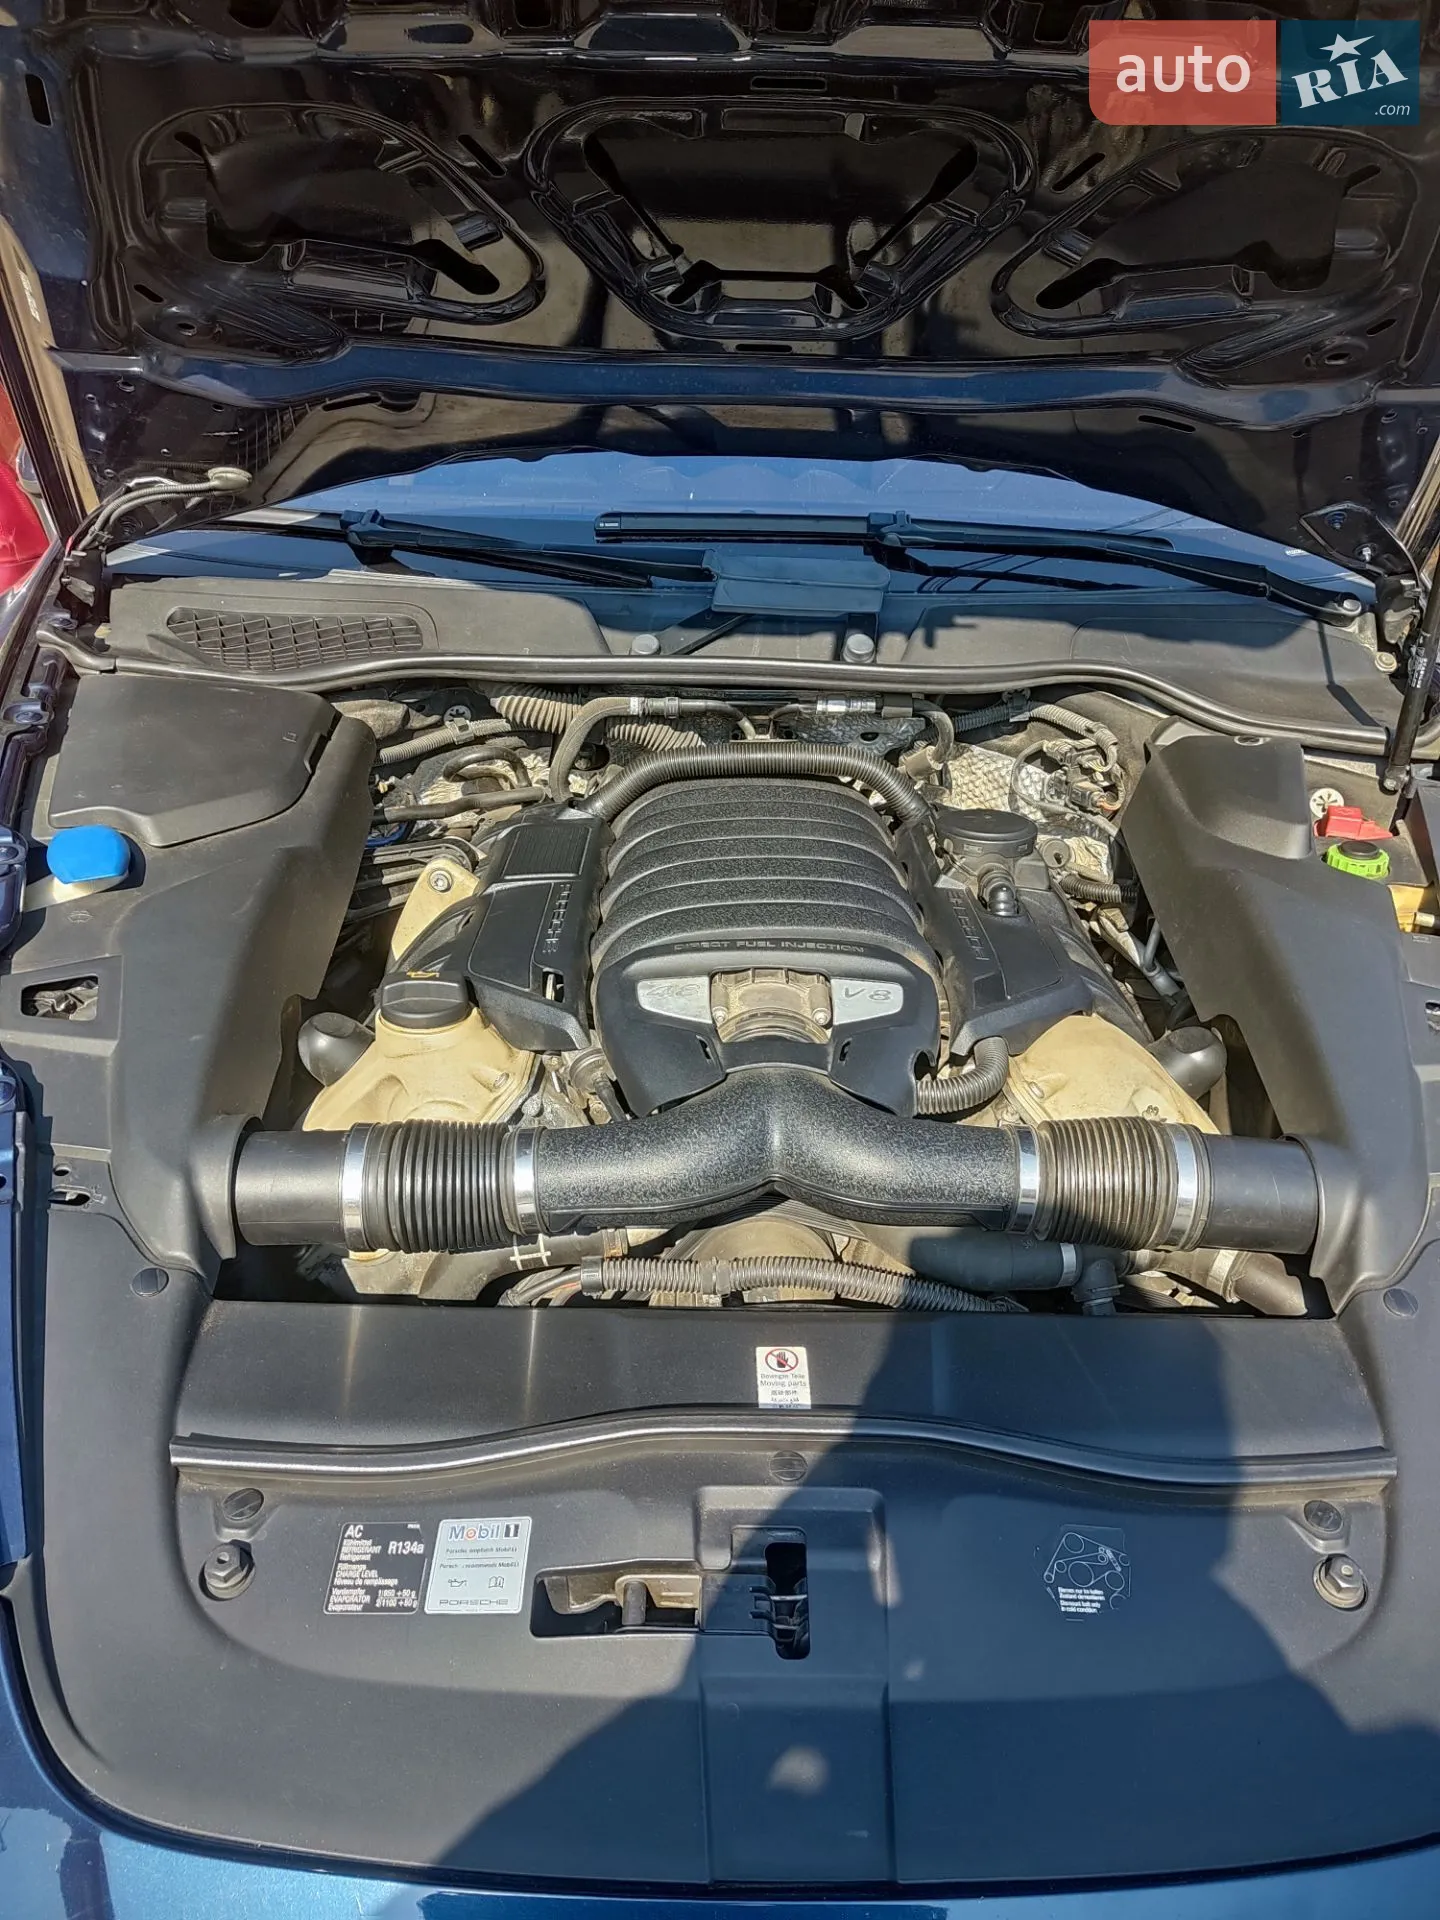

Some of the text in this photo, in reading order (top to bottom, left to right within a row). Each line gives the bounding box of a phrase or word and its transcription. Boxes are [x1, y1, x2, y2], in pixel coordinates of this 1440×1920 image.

[736, 940, 776, 948] FUEL
[780, 940, 865, 953] INJECTION
[344, 1524, 364, 1538] AC
[448, 1523, 500, 1540] Mobil
[387, 1540, 425, 1555] R134a
